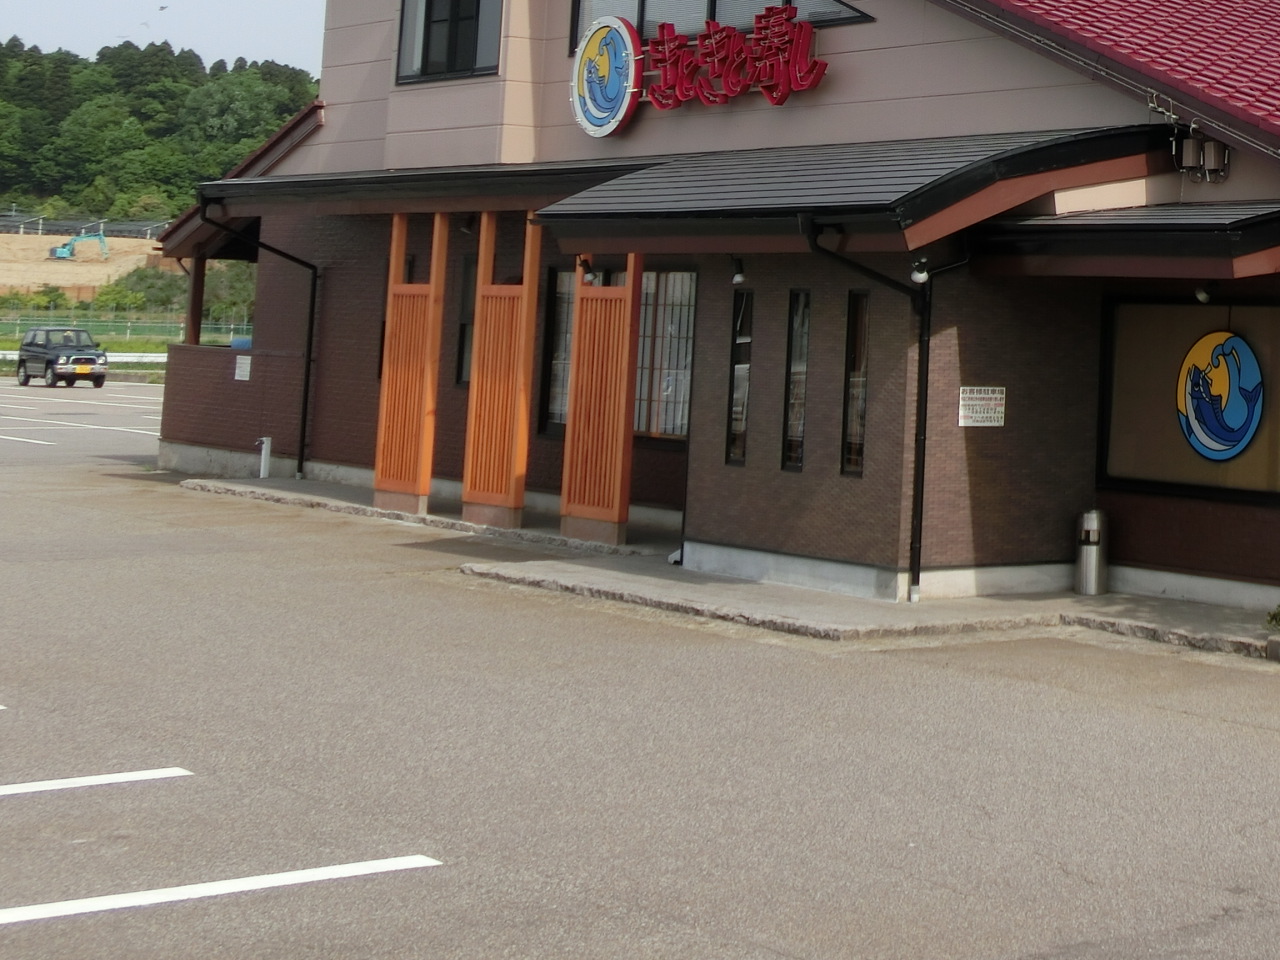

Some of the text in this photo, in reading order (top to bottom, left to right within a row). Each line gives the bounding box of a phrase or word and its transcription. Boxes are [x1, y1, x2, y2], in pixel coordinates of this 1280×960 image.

[649, 4, 829, 110] きときと寿し
